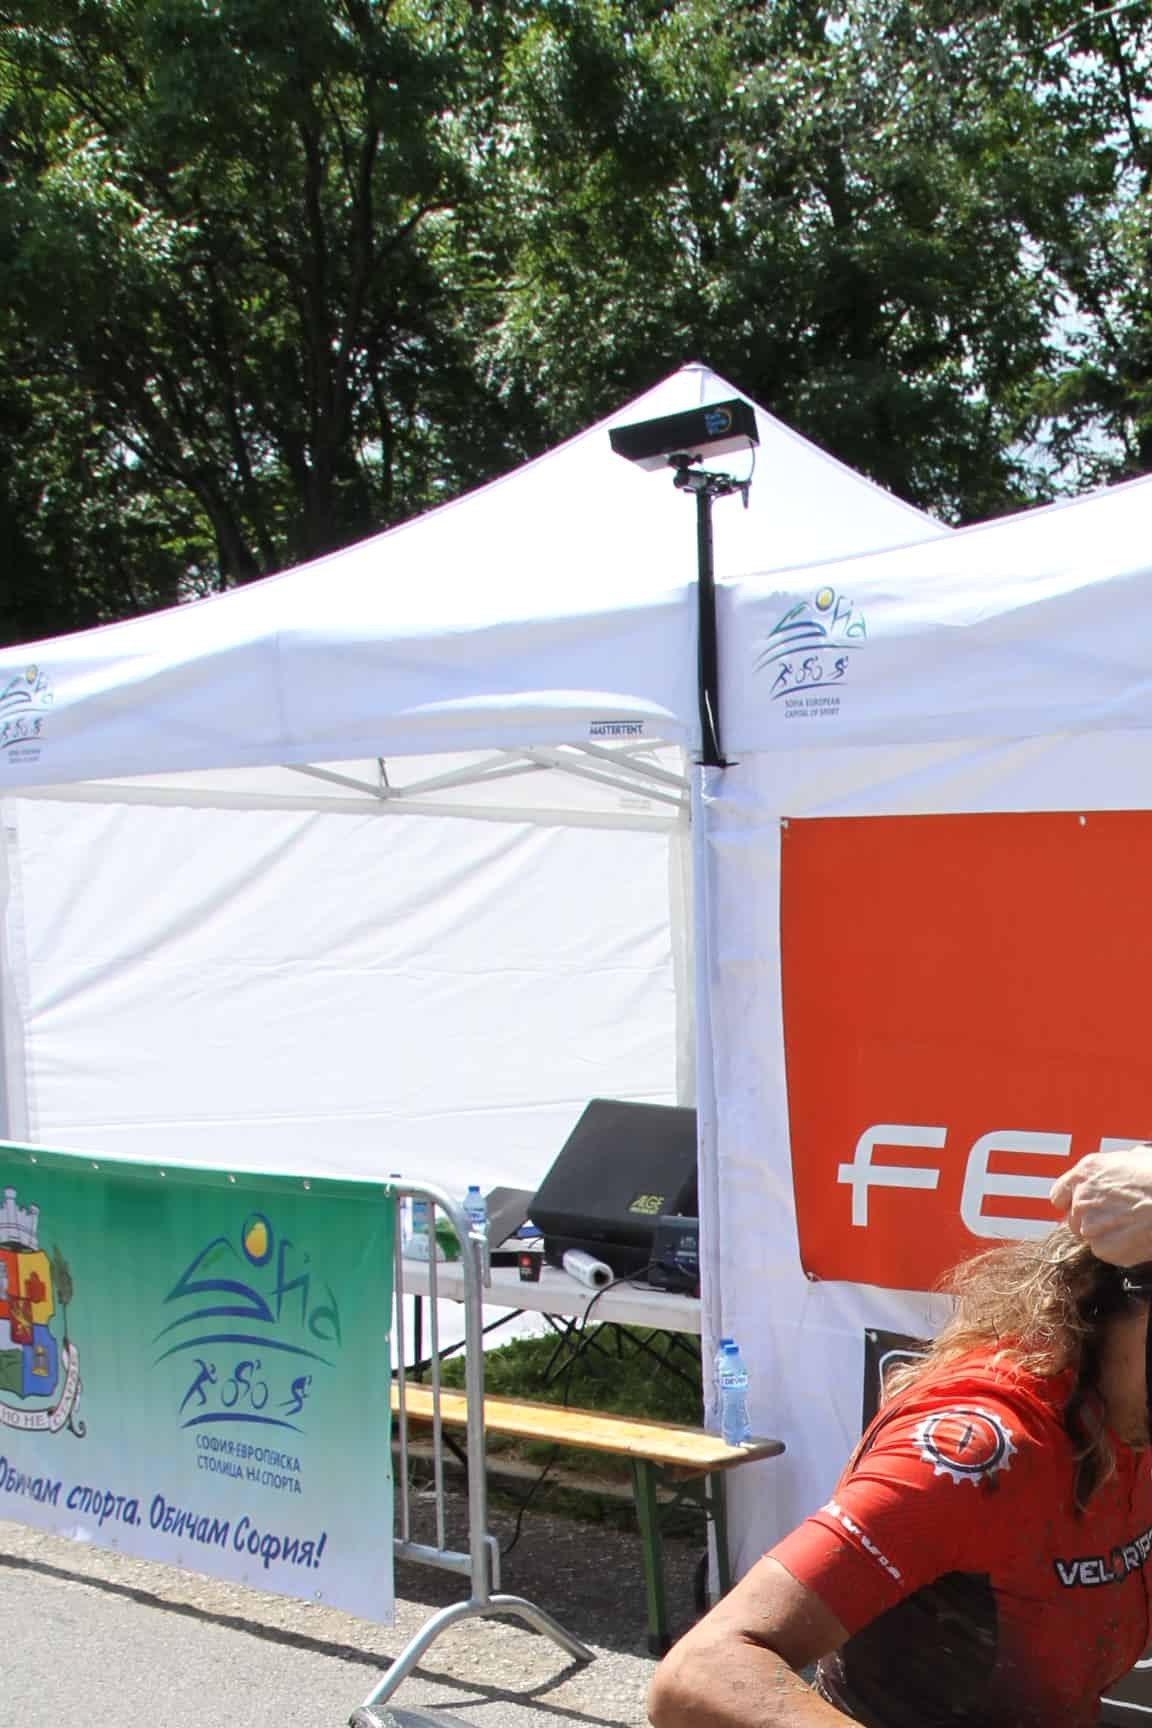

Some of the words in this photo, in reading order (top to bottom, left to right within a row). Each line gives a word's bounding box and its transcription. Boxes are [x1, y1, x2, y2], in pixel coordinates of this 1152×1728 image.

[66, 1484, 142, 1526] спорта.
[150, 1494, 230, 1548] Обичам
[233, 1516, 328, 1569] София!
